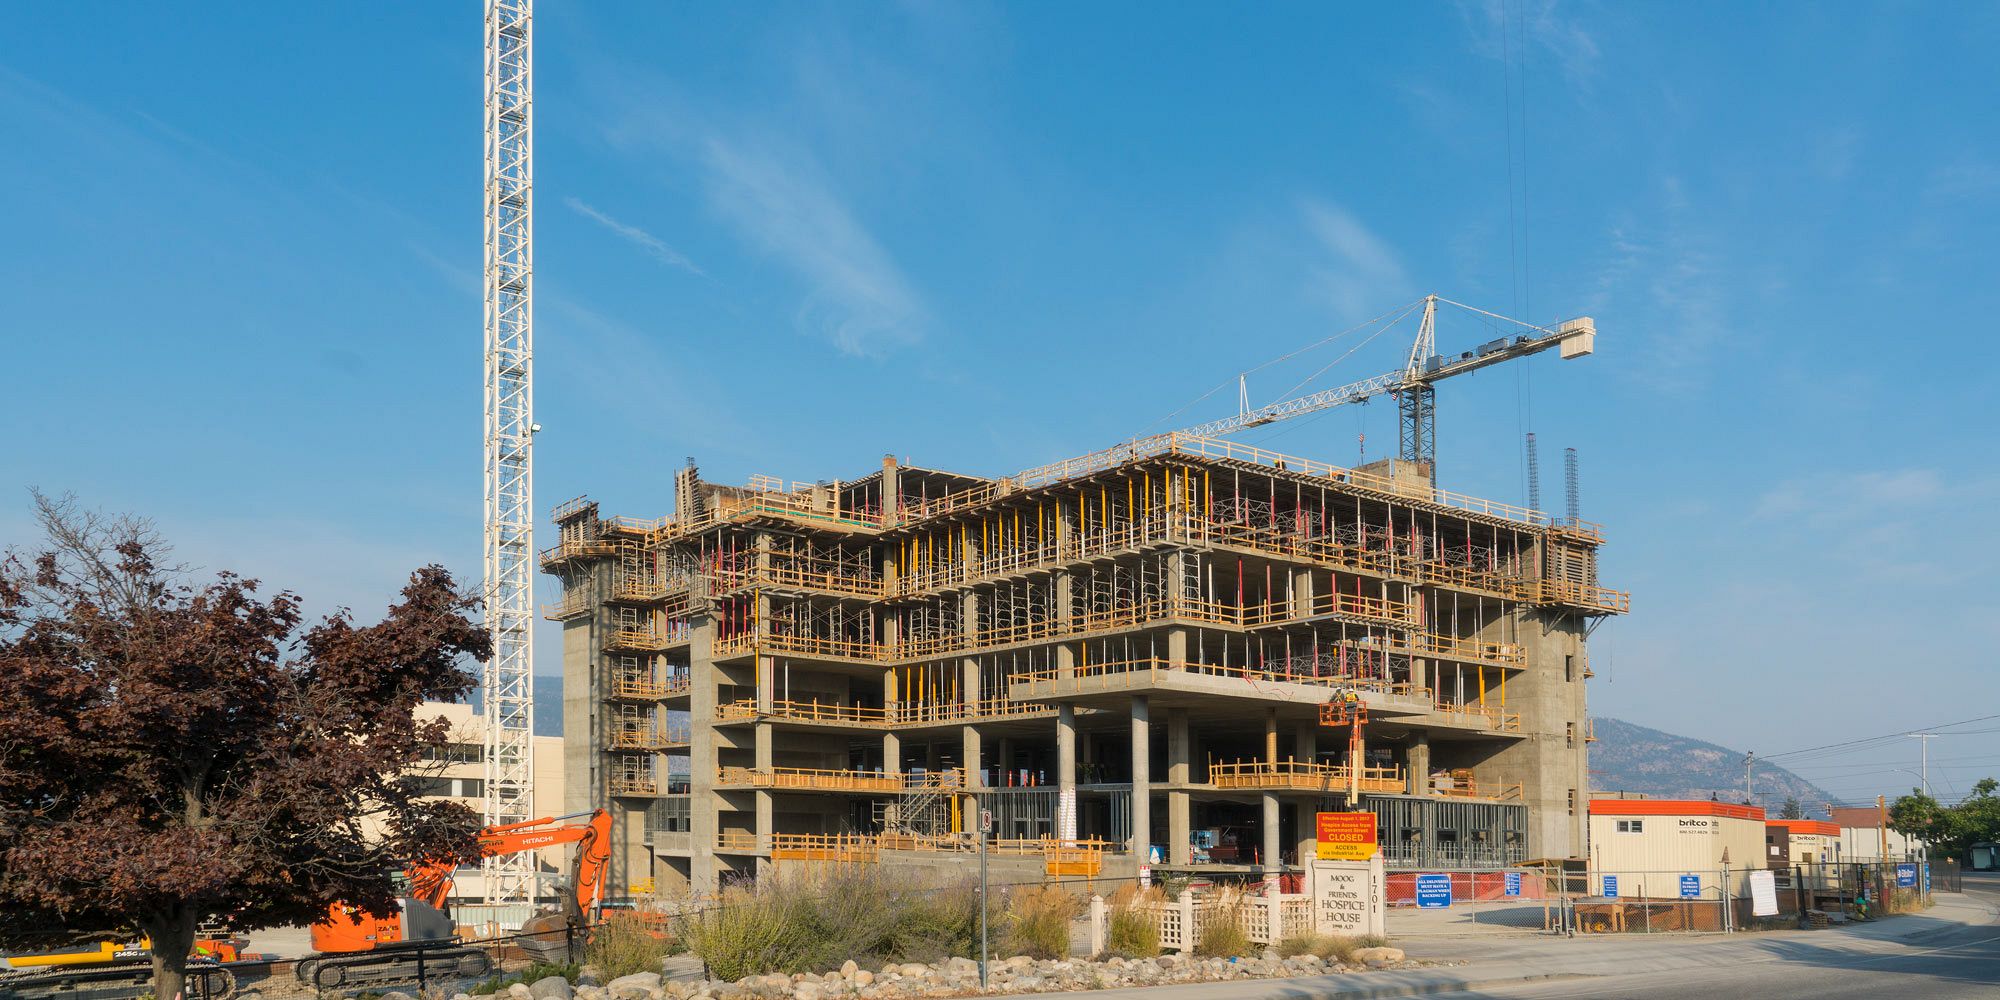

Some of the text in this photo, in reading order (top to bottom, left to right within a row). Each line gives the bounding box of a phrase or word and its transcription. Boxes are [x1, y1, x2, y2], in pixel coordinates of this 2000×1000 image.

[1679, 819, 1708, 827] britco
[522, 836, 554, 845] HITACHI
[1328, 833, 1364, 841] CLOSED
[1328, 891, 1357, 899] FRIENDS
[1321, 900, 1365, 911] HOSPICE
[1326, 912, 1361, 923] HOUSE
